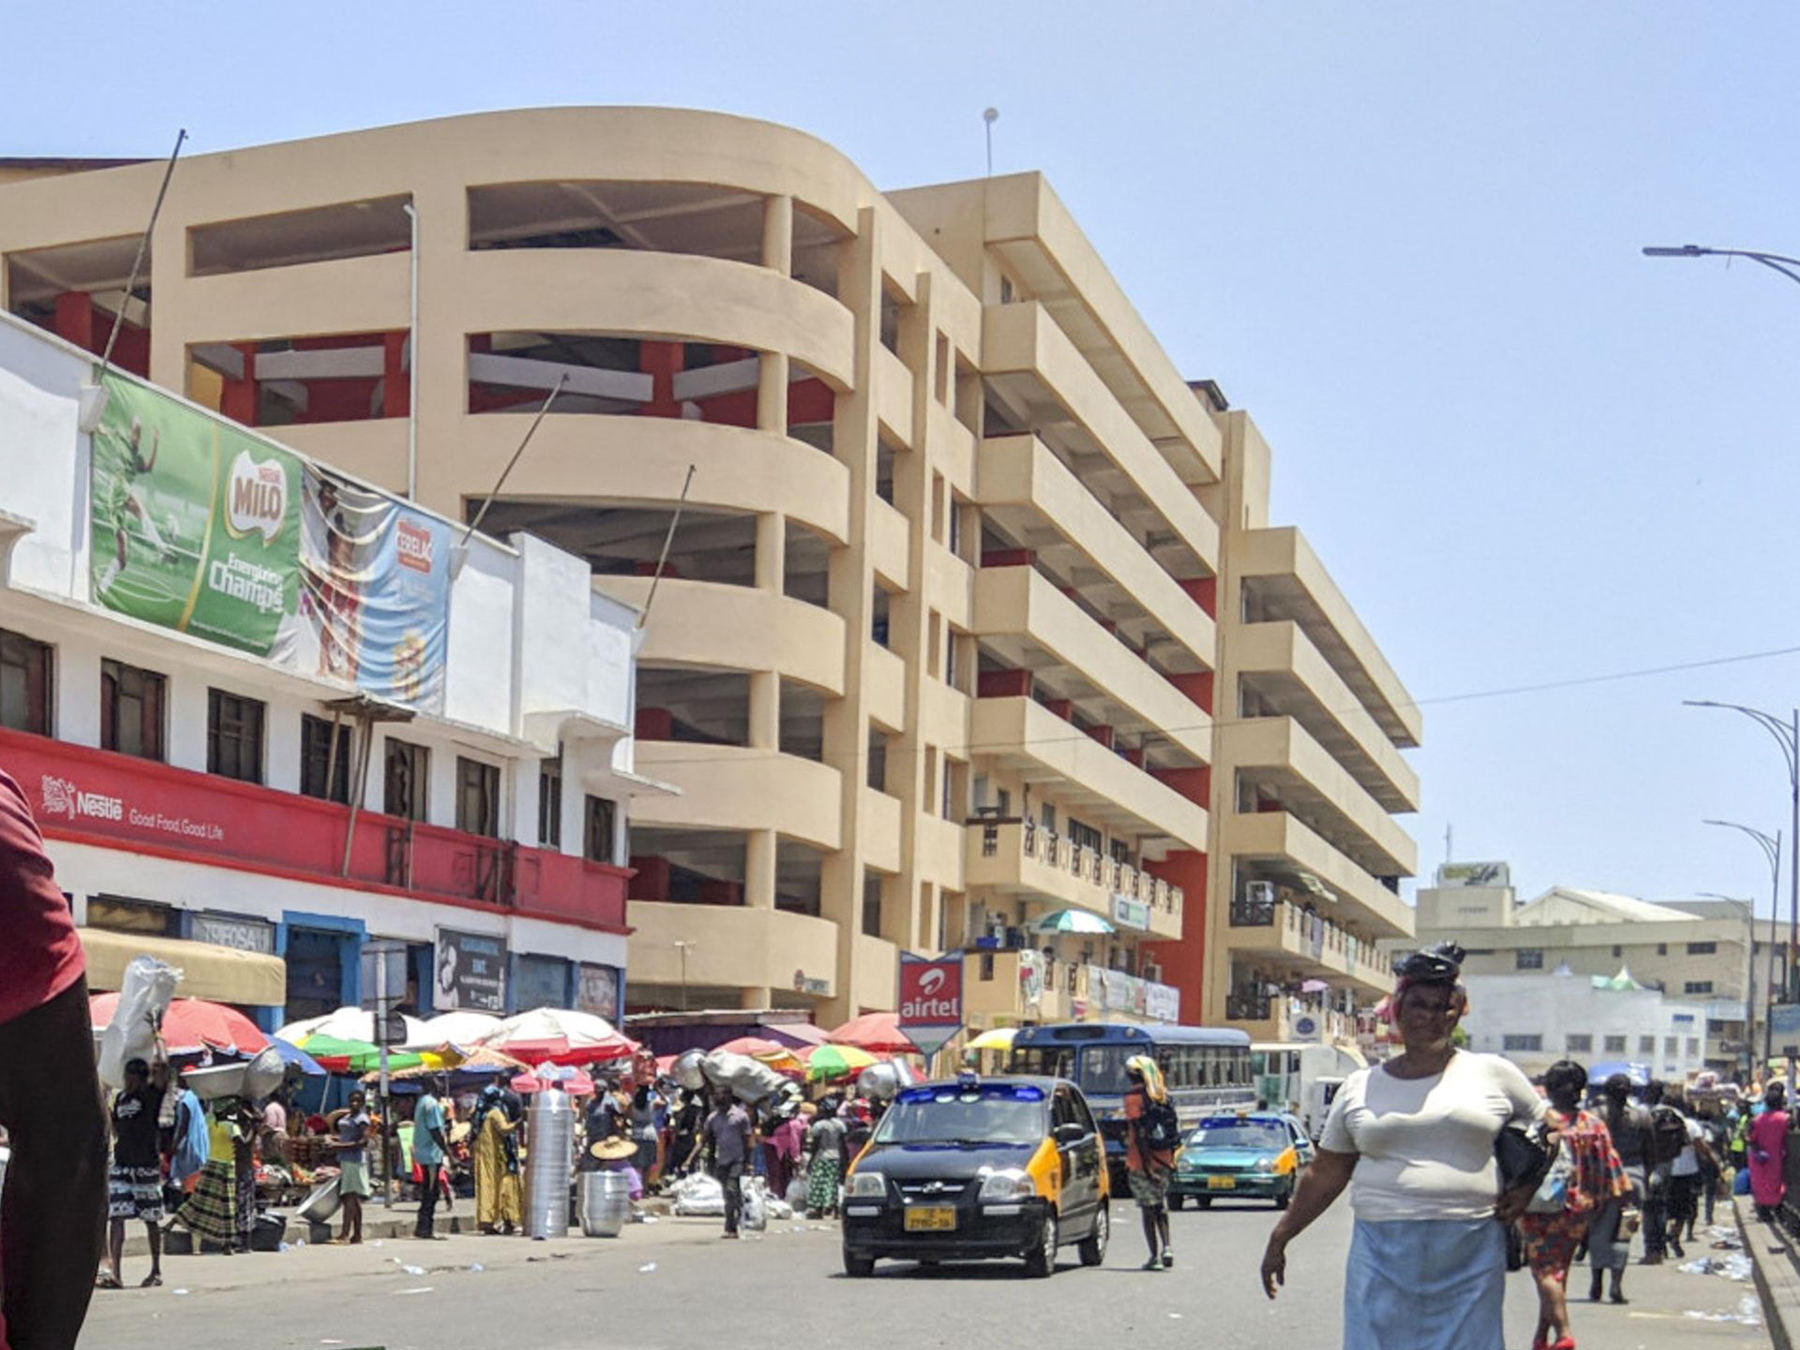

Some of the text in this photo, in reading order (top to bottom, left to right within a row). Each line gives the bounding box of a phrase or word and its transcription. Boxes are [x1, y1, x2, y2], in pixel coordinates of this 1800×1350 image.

[233, 476, 282, 521] MILO
[209, 560, 285, 614] Champs
[129, 808, 154, 828] Good
[182, 818, 205, 838] Good
[208, 825, 224, 841] Life
[902, 996, 958, 1018] airtel
